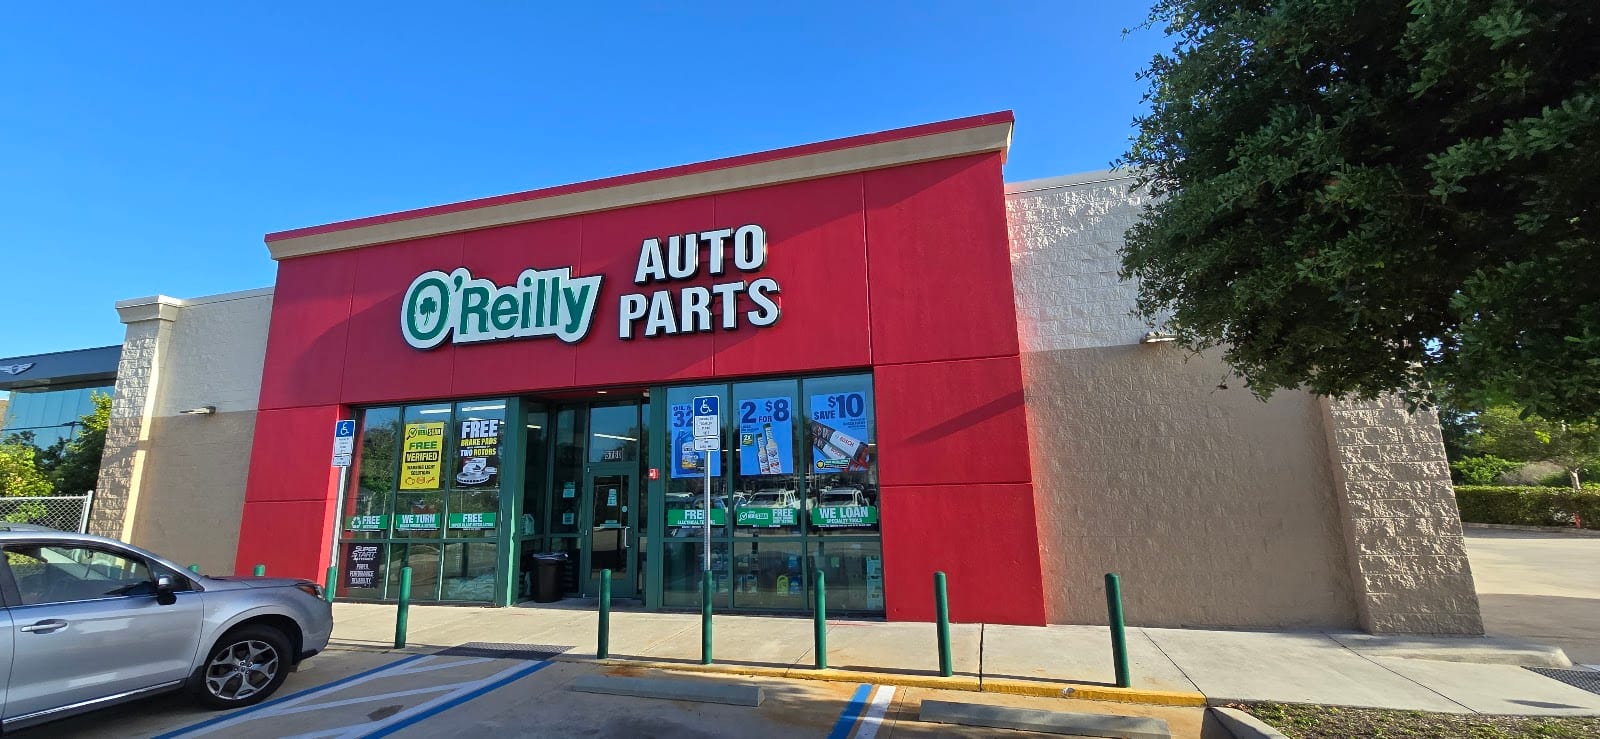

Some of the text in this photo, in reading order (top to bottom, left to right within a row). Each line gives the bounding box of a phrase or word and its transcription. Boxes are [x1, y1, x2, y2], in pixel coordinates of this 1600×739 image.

[635, 224, 767, 284] AUTO
[404, 271, 594, 343] O'Reilly
[618, 278, 782, 339] PARTS
[740, 399, 790, 423] 2 FOR $8
[813, 393, 864, 420] SAVE $10
[461, 419, 499, 438] FREE
[409, 441, 437, 450] FREE
[460, 439, 480, 447] BRAKE
[406, 451, 438, 462] VERIFIED
[460, 448, 497, 457] TWO ROTORS
[462, 513, 483, 523] FREE
[772, 508, 794, 517] FREE
[819, 507, 869, 519] WE LOAN
[362, 515, 381, 525] FREE
[401, 513, 436, 524] WE TURN
